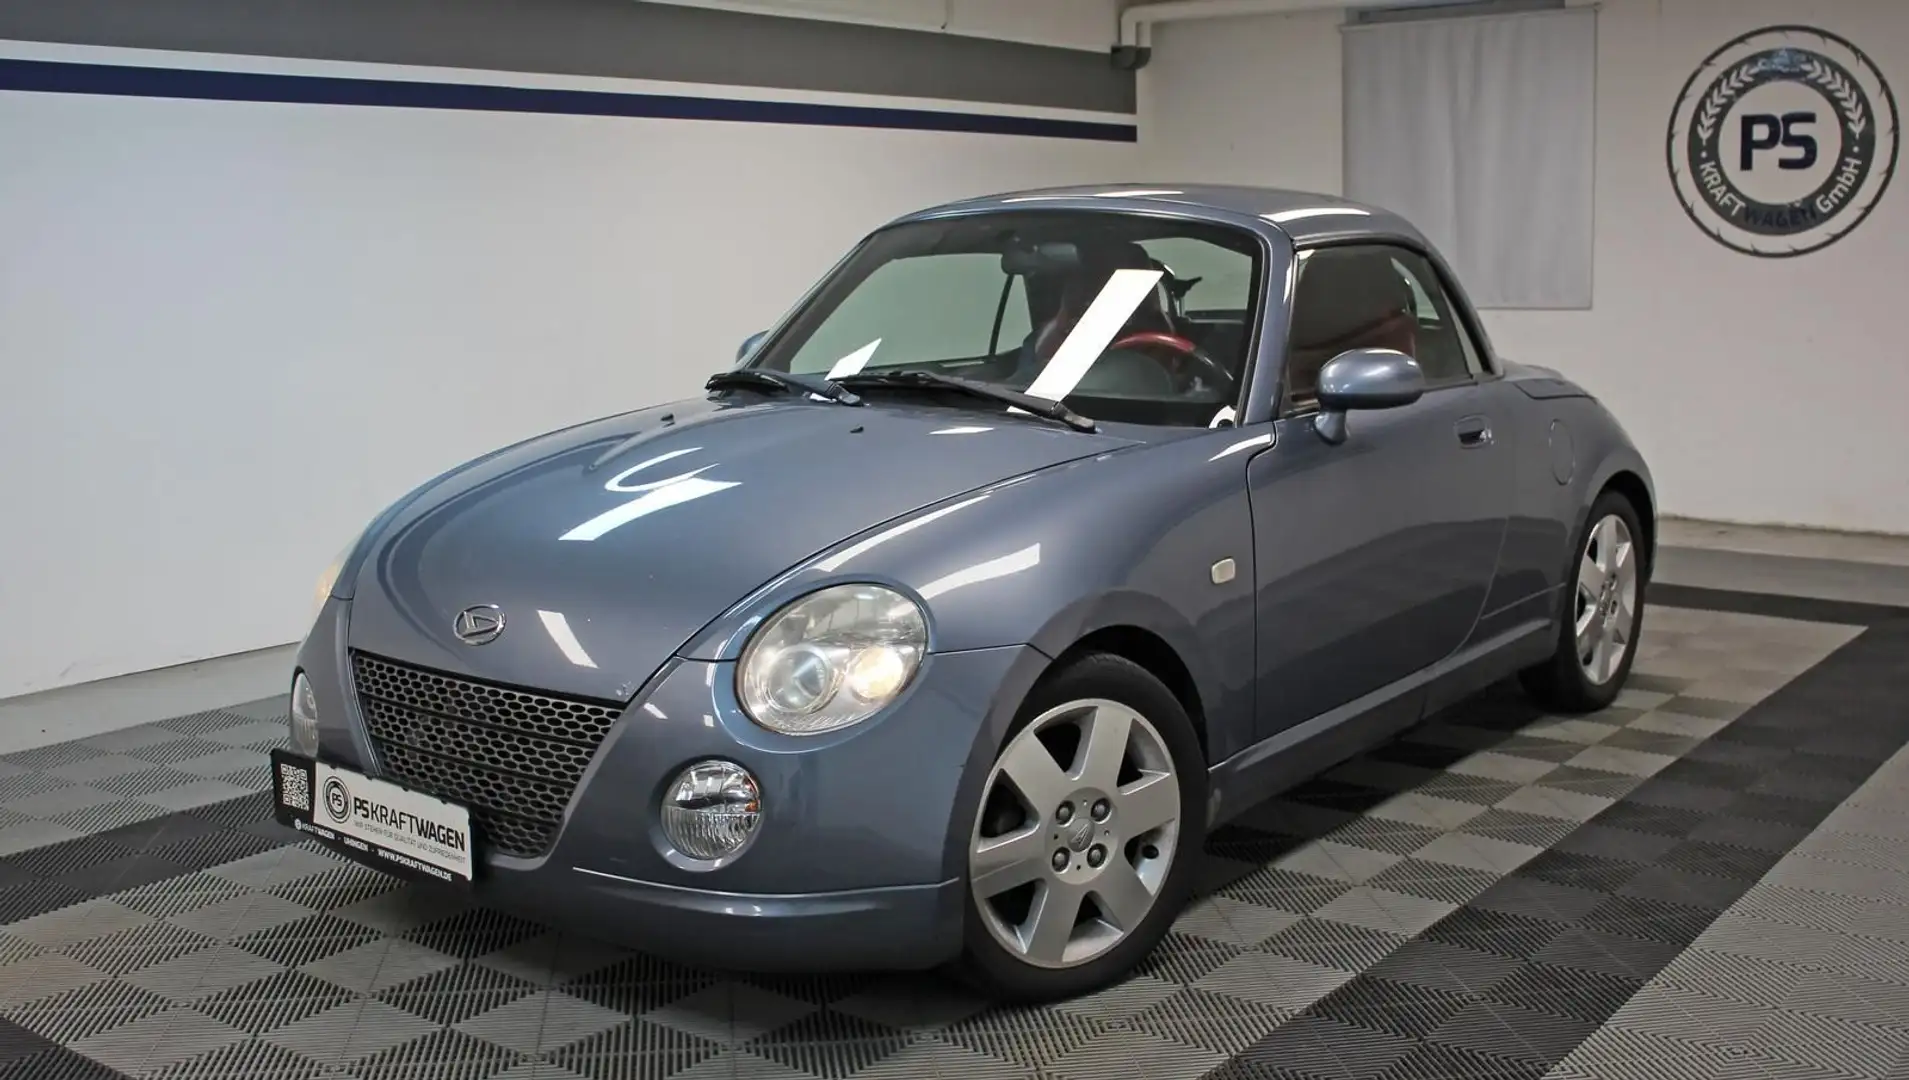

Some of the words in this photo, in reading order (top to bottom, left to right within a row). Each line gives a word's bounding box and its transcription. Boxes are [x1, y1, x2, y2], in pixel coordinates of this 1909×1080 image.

[1740, 111, 1818, 171] PS
[1816, 157, 1862, 214] GmbH
[331, 792, 343, 807] PS
